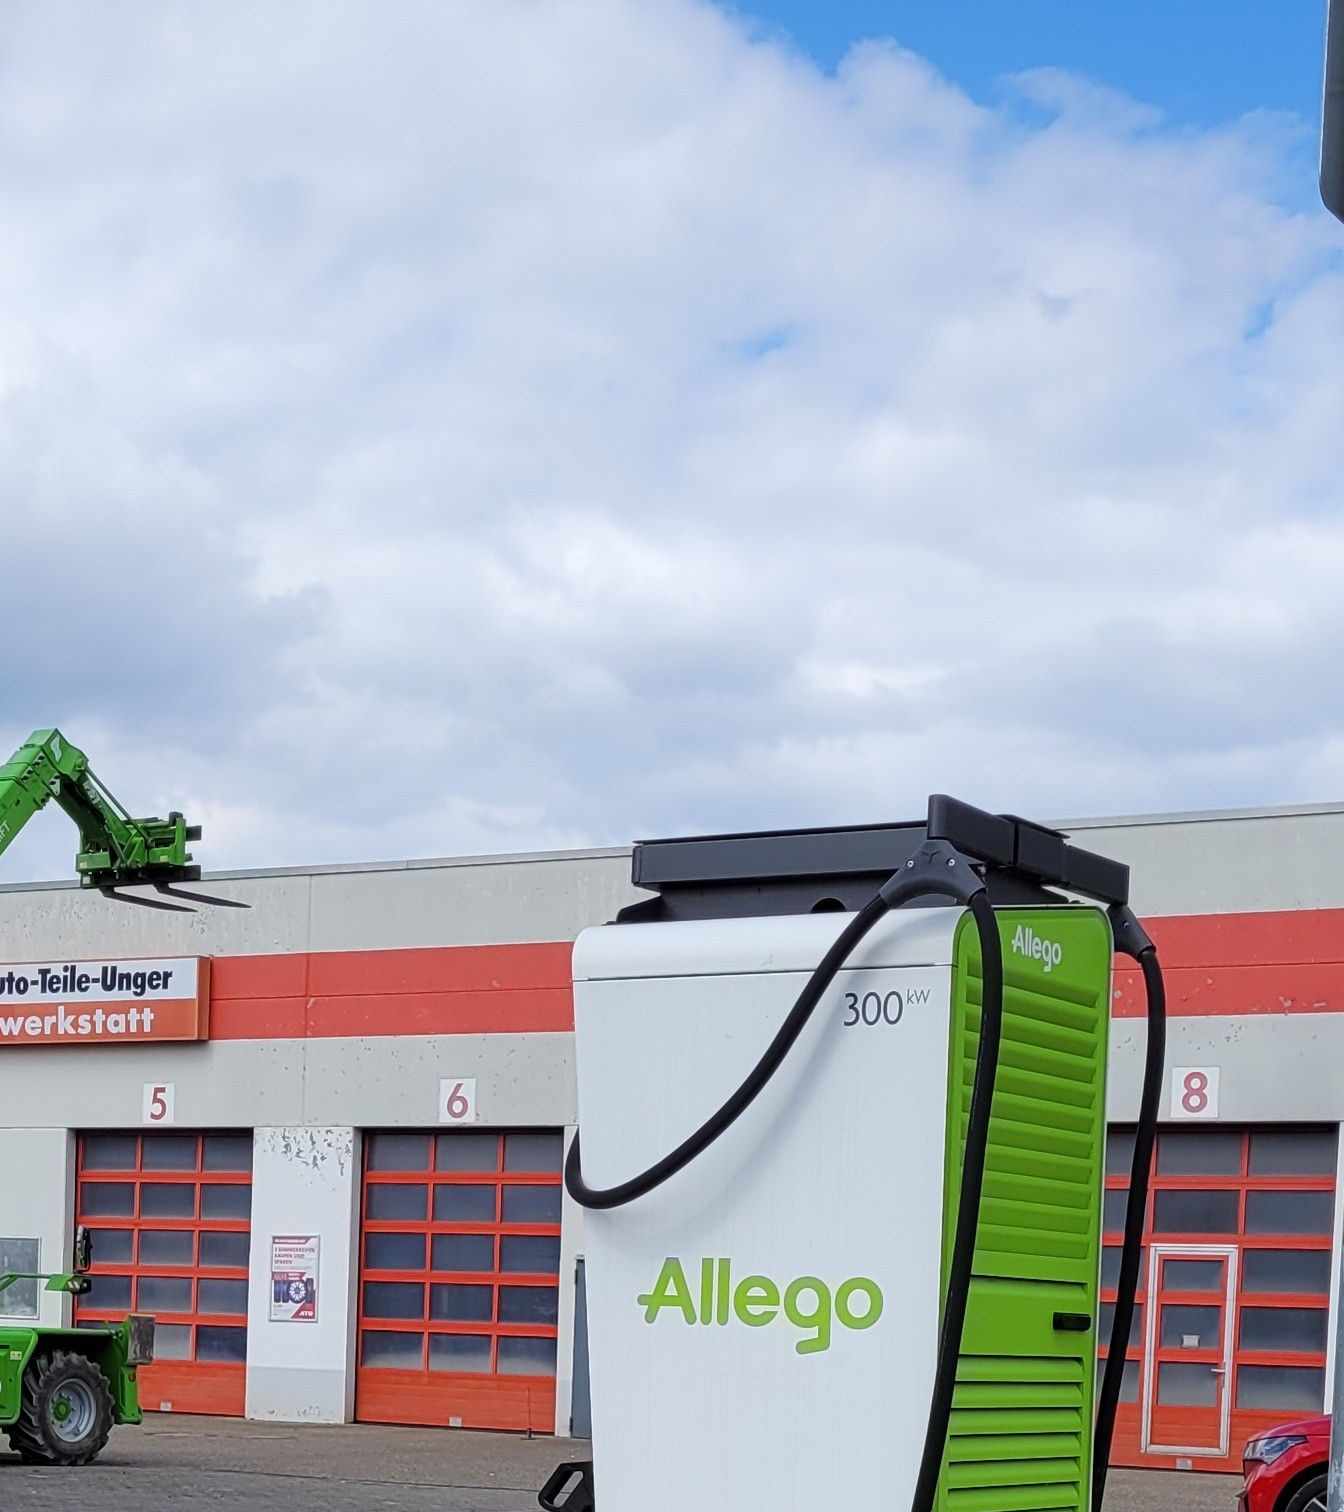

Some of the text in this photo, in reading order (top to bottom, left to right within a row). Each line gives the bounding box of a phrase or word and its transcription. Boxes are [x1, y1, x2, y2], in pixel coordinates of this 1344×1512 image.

[1011, 925, 1062, 972] Allego
[843, 990, 904, 1027] 300
[150, 1087, 167, 1121] 5
[447, 1083, 468, 1119] 6
[1181, 1071, 1208, 1113] 8
[637, 1257, 884, 1355] Allego
